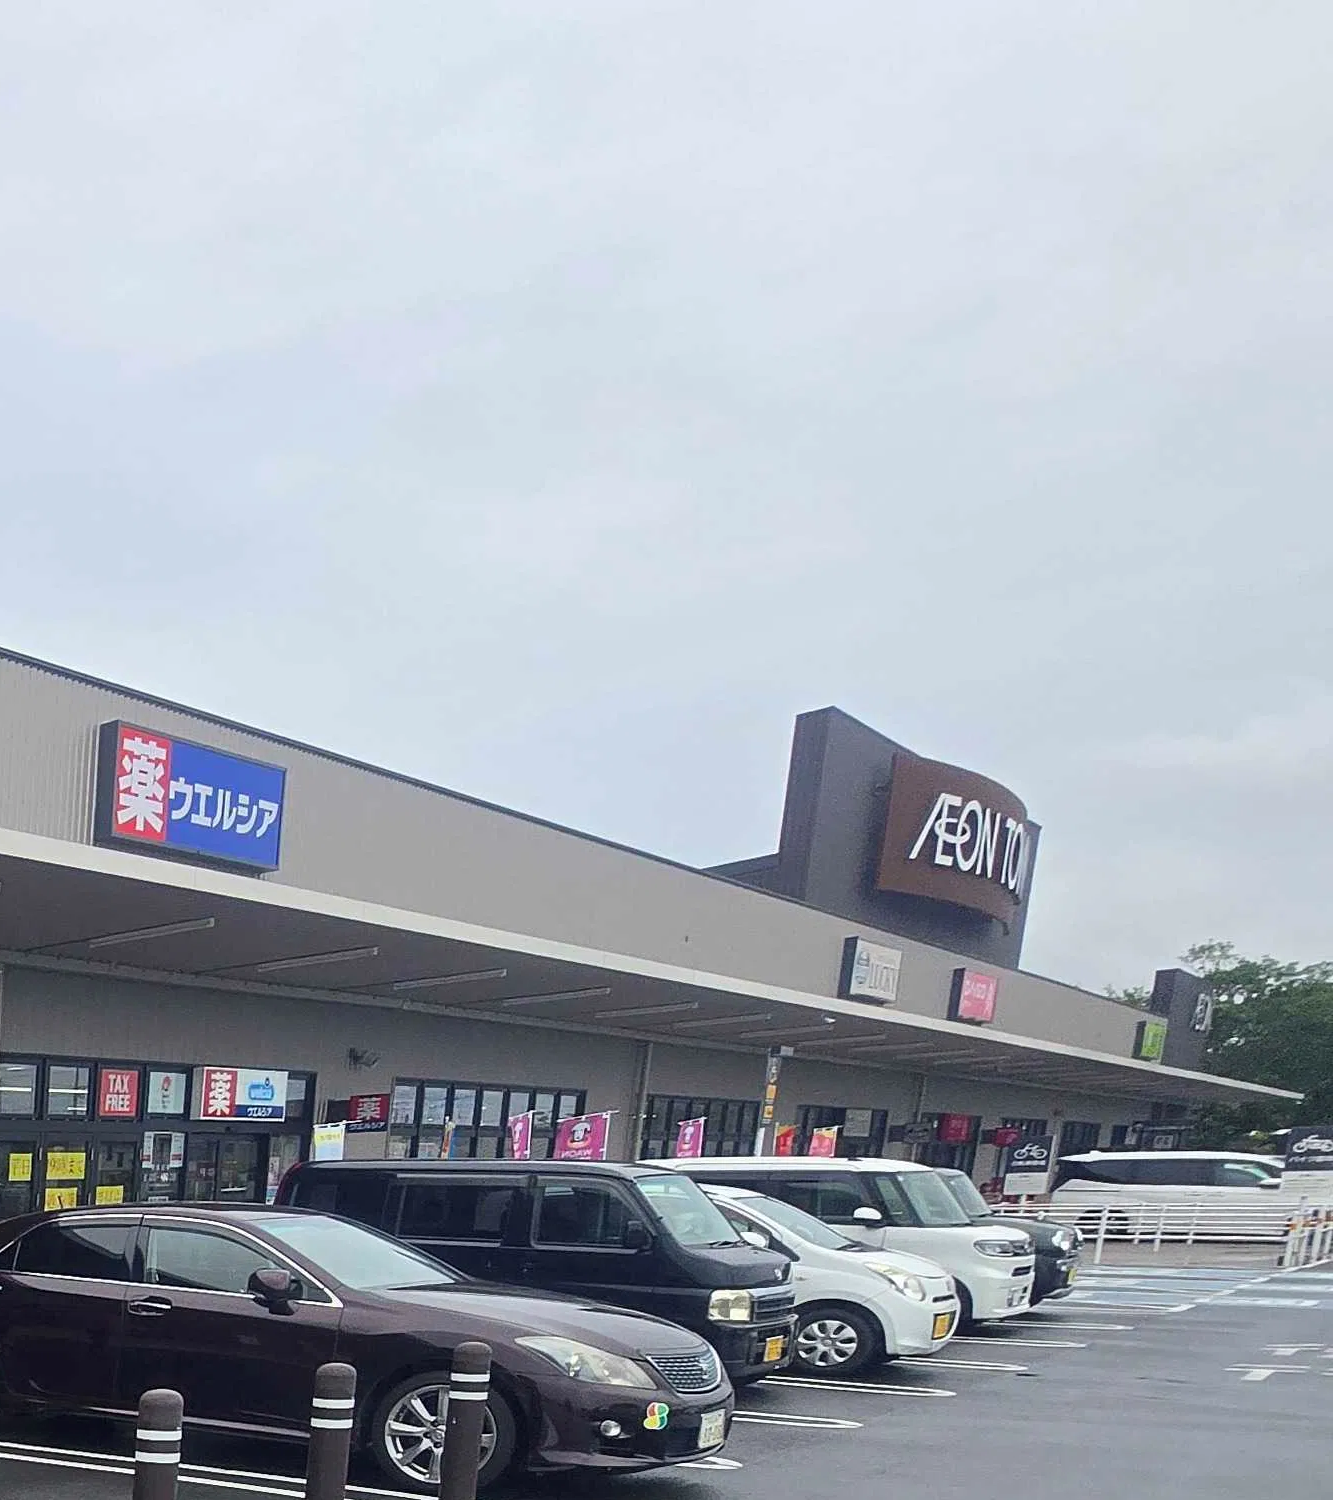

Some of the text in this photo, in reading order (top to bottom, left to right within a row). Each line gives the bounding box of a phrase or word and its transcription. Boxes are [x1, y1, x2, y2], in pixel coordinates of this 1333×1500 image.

[116, 737, 280, 839] 薬 ウエルシア
[107, 1074, 130, 1094] TAX
[207, 1071, 232, 1116] 薬
[105, 1094, 131, 1112] FREE
